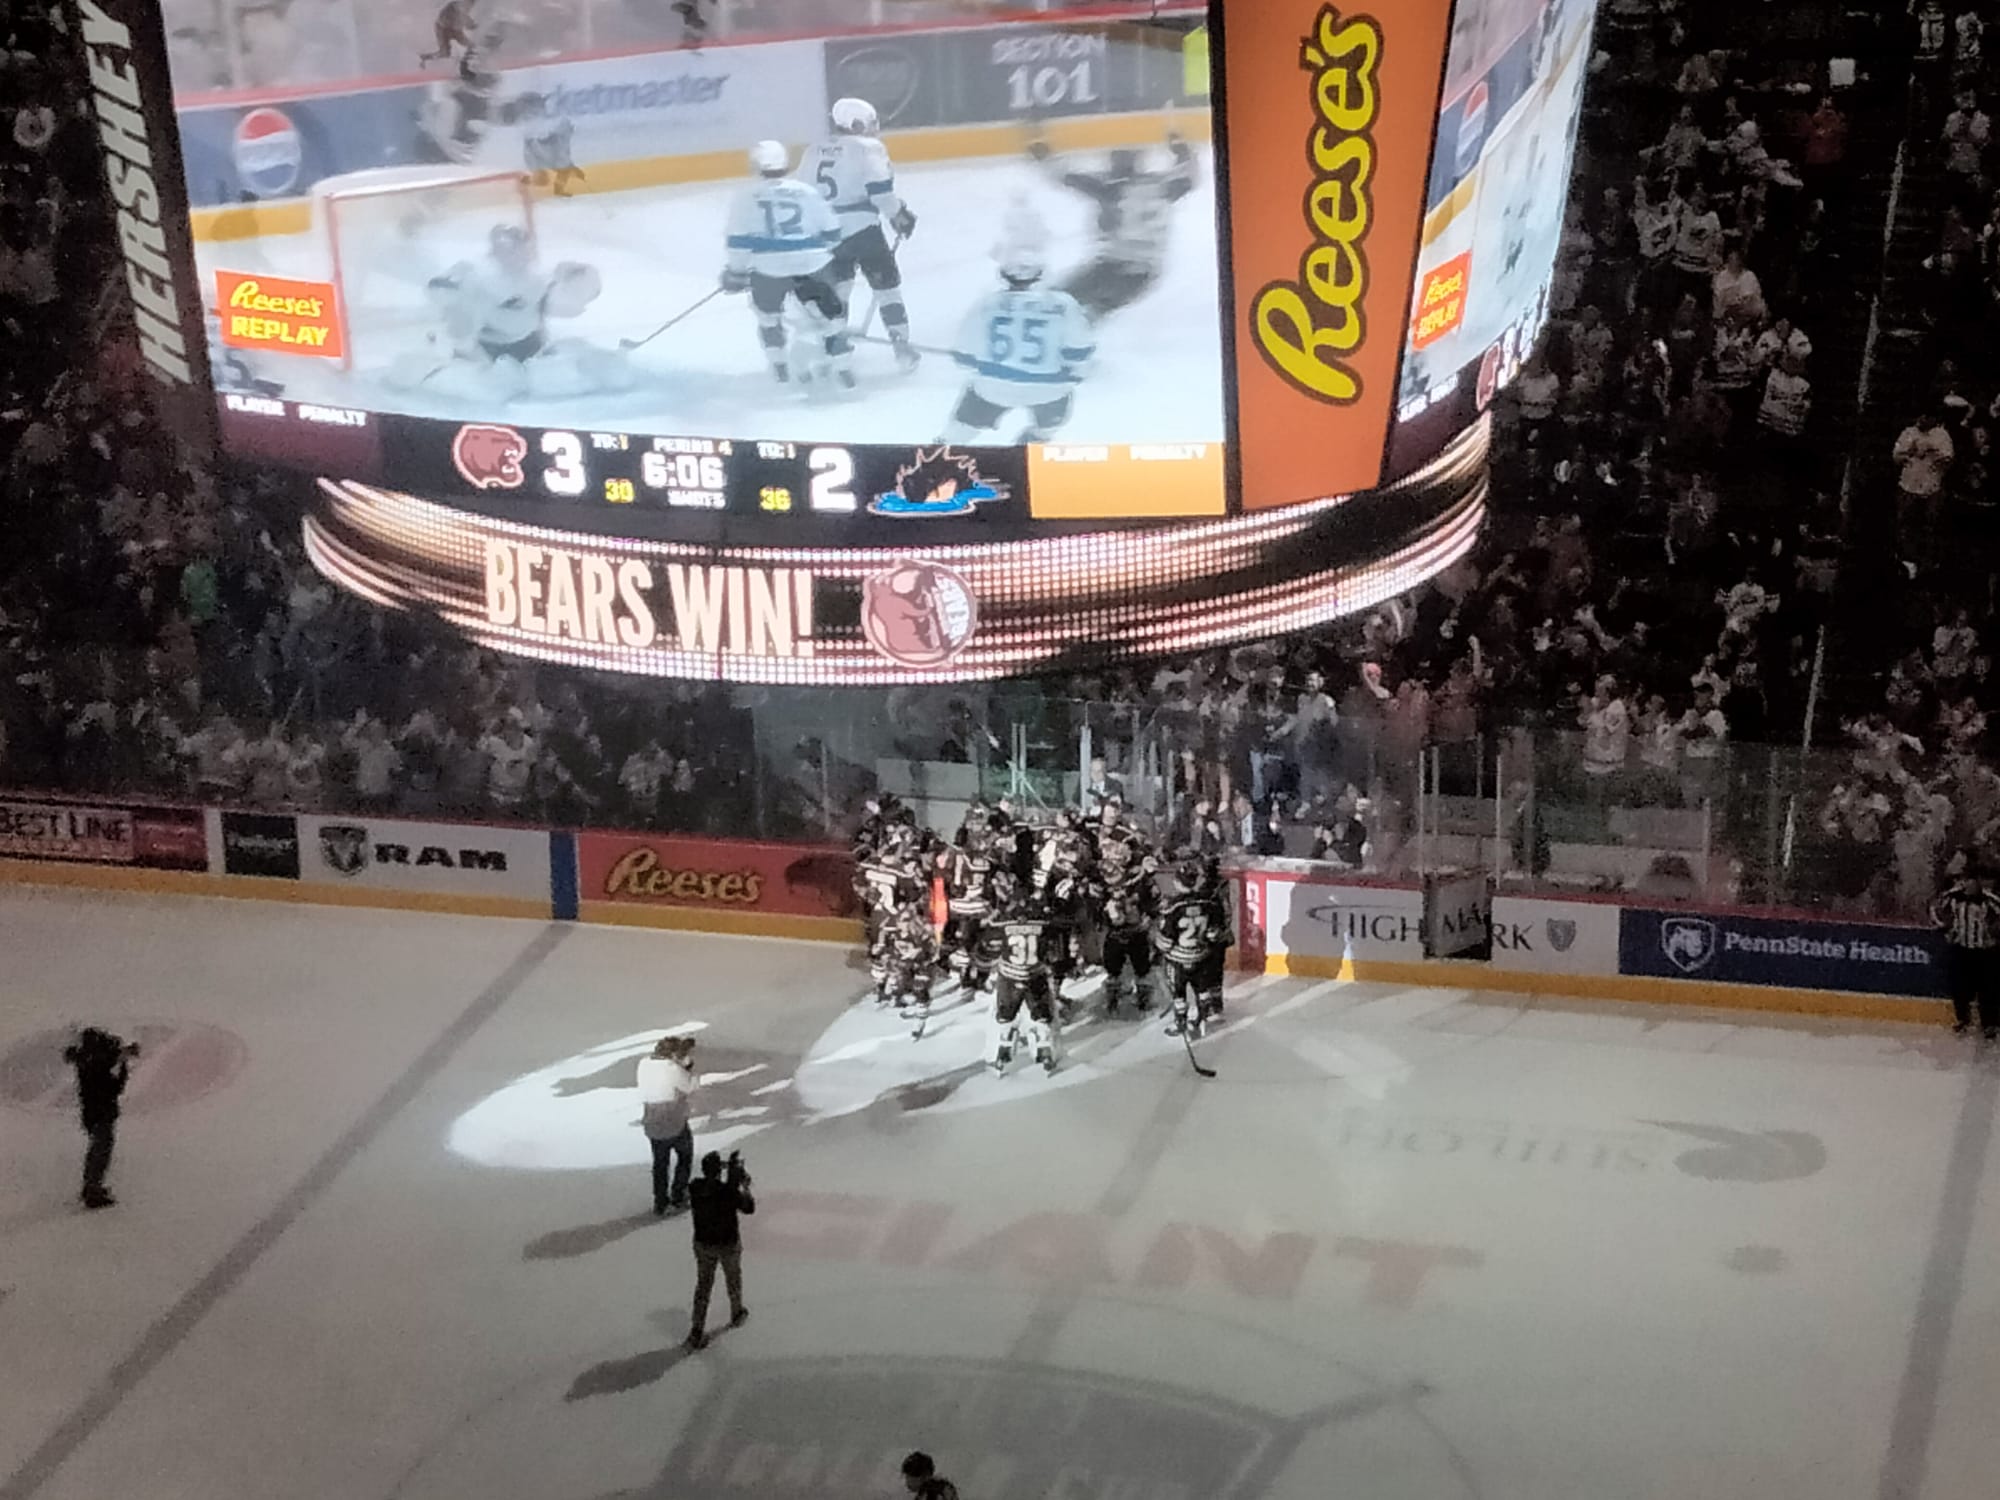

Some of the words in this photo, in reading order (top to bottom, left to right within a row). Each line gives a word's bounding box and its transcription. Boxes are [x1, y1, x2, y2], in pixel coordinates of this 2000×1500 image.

[1008, 60, 1100, 108] 101
[77, 0, 192, 384] HERSHEY
[1252, 4, 1381, 403] Reese's
[757, 200, 803, 238] 12
[230, 280, 324, 317] Reese's
[230, 315, 329, 346] REPLAY
[540, 430, 588, 496] 3
[641, 451, 725, 490] 6:06
[809, 446, 858, 511] 2
[485, 540, 655, 647] BEARS
[667, 563, 813, 657] WIN!
[374, 842, 508, 872] RAM
[604, 846, 764, 904] Reese's
[1007, 935, 1039, 966] 31
[1849, 940, 1930, 965] Health
